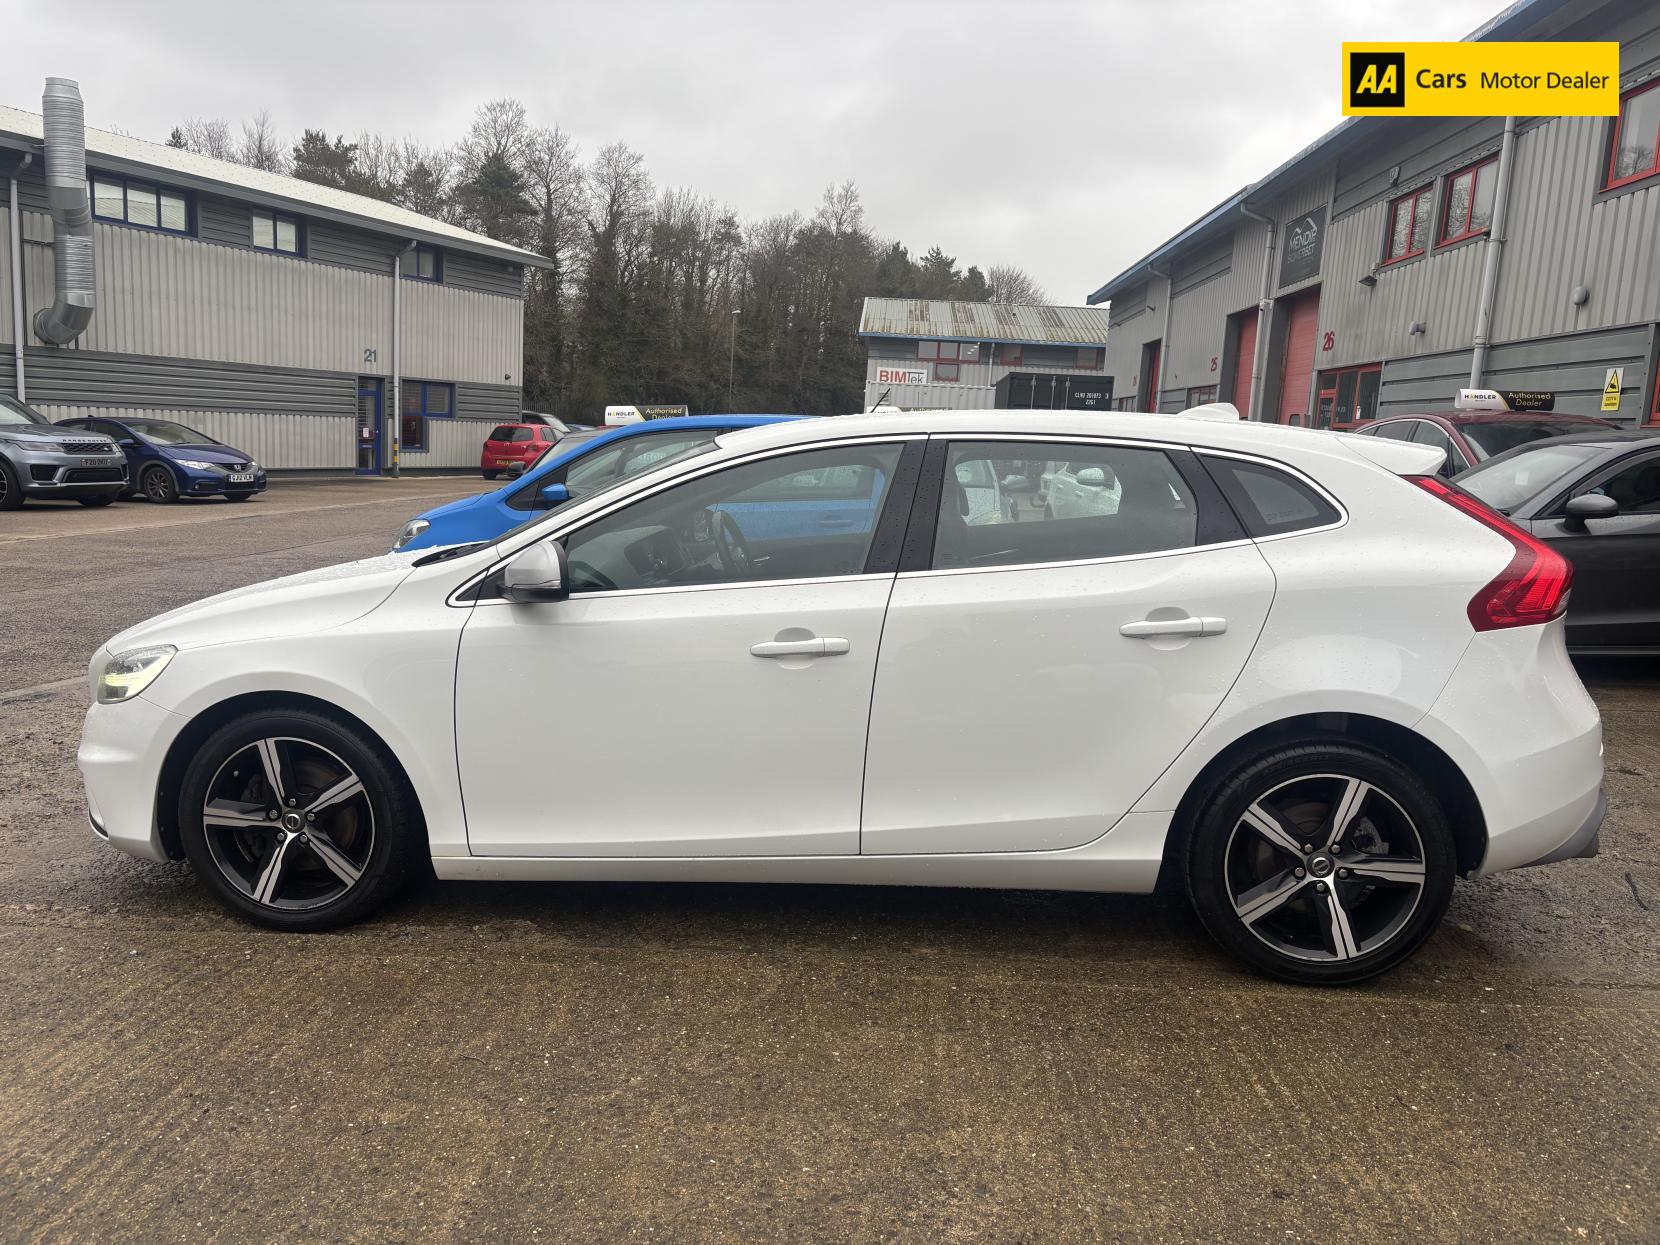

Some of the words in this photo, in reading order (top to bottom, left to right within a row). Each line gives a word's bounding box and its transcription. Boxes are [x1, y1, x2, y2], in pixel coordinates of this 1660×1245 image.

[1322, 331, 1335, 352] 26
[363, 348, 377, 363] 21
[879, 369, 925, 384] BIMTek
[1508, 392, 1551, 400] Authorised
[1515, 398, 1543, 407] Dealer
